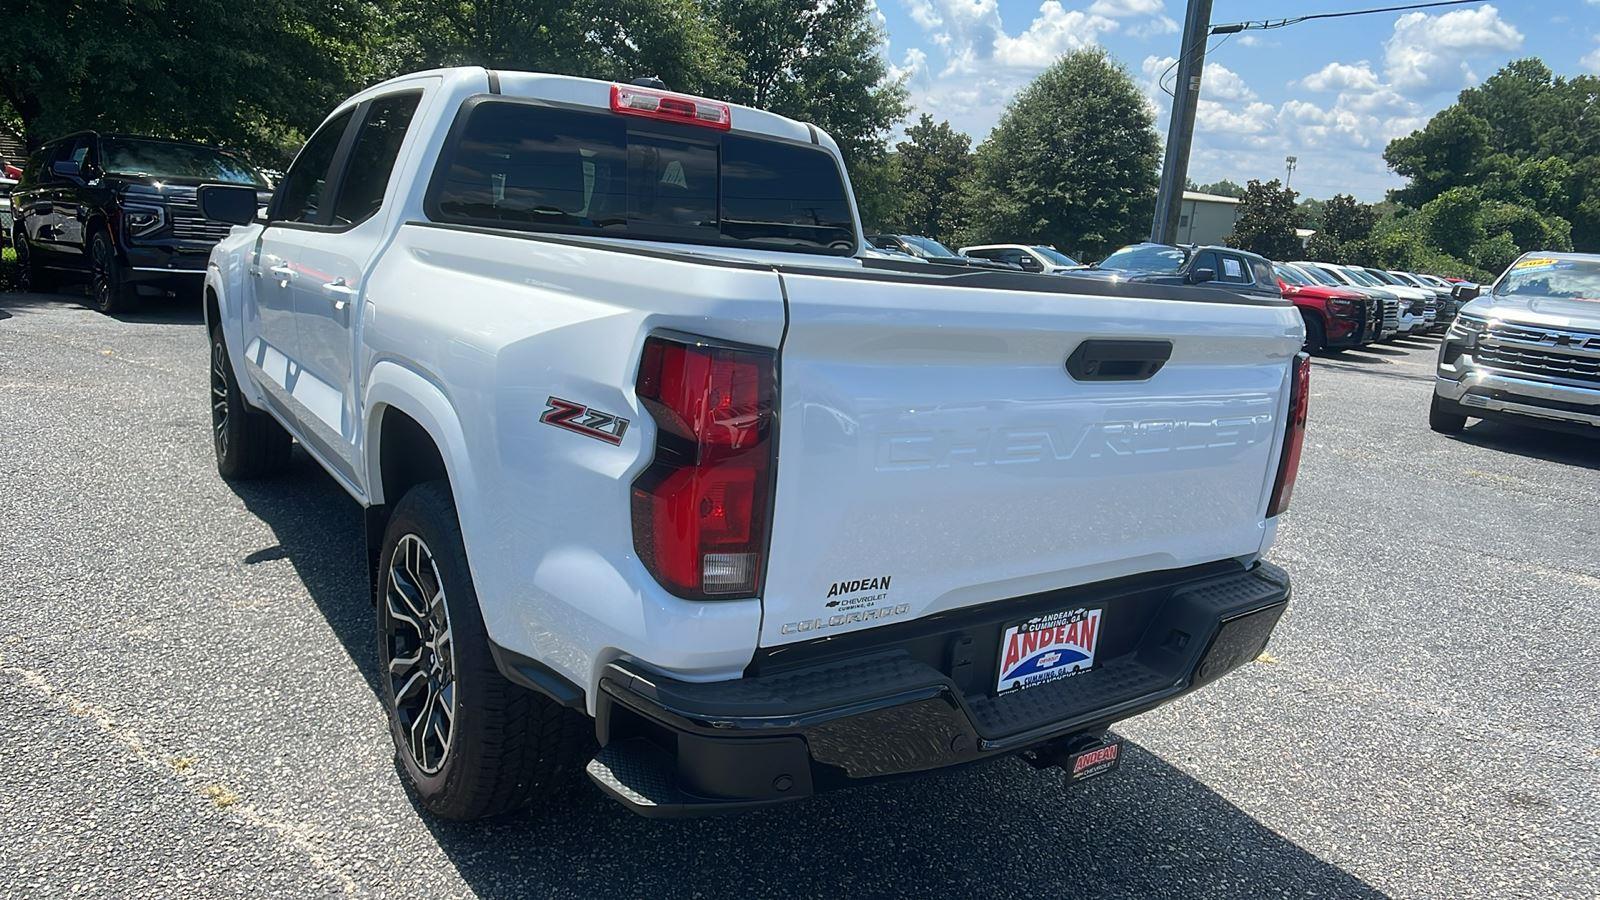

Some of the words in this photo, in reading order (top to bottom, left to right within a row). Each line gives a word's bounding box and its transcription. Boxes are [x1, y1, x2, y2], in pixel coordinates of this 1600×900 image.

[540, 395, 630, 447] Z71
[875, 414, 1273, 472] CHEVROLET
[827, 576, 892, 598] ANDEAN
[841, 593, 887, 606] CHEVROLET
[781, 602, 911, 635] COLORADO
[1041, 610, 1074, 622] ANDEAN
[1071, 615, 1081, 623] GA
[1002, 615, 1097, 676] ANDEAN
[1073, 744, 1118, 773] ANDEAN
